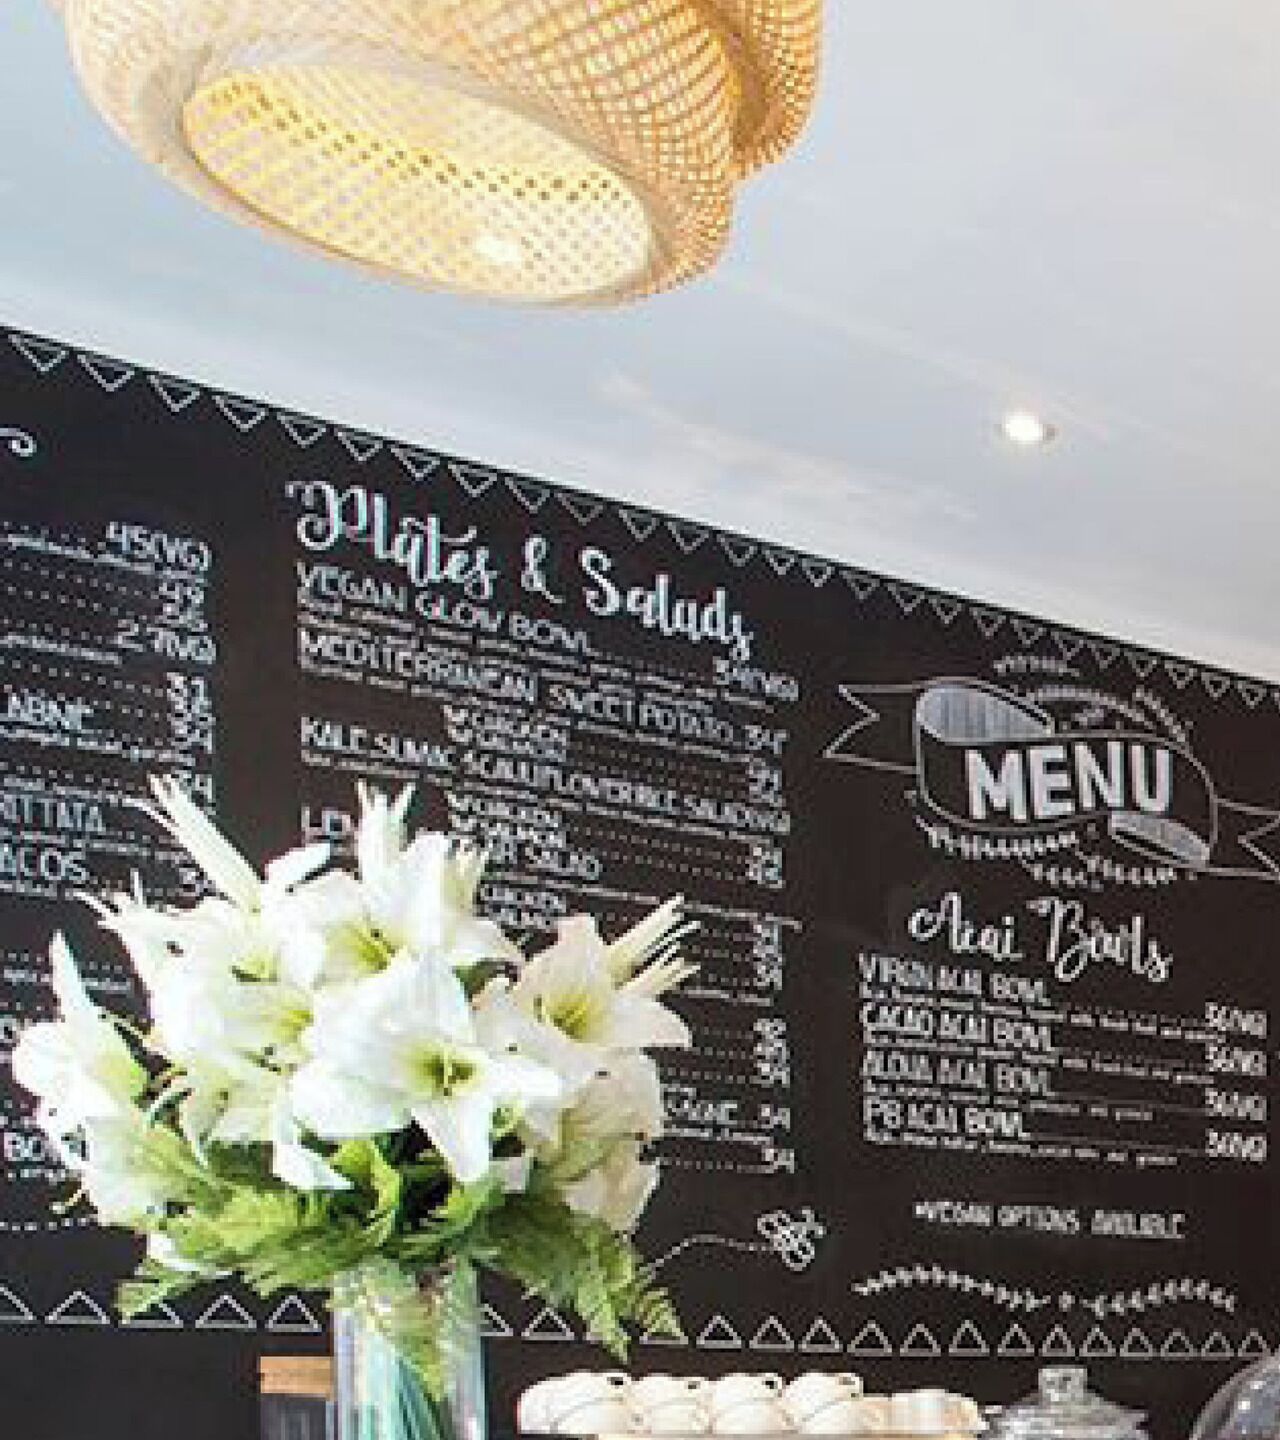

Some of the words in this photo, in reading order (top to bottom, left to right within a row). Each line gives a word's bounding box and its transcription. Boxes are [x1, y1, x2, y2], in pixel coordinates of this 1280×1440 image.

[296, 560, 407, 613] VEGAN
[521, 535, 564, 605] &
[579, 547, 755, 663] Salads
[965, 739, 1173, 823] MENU
